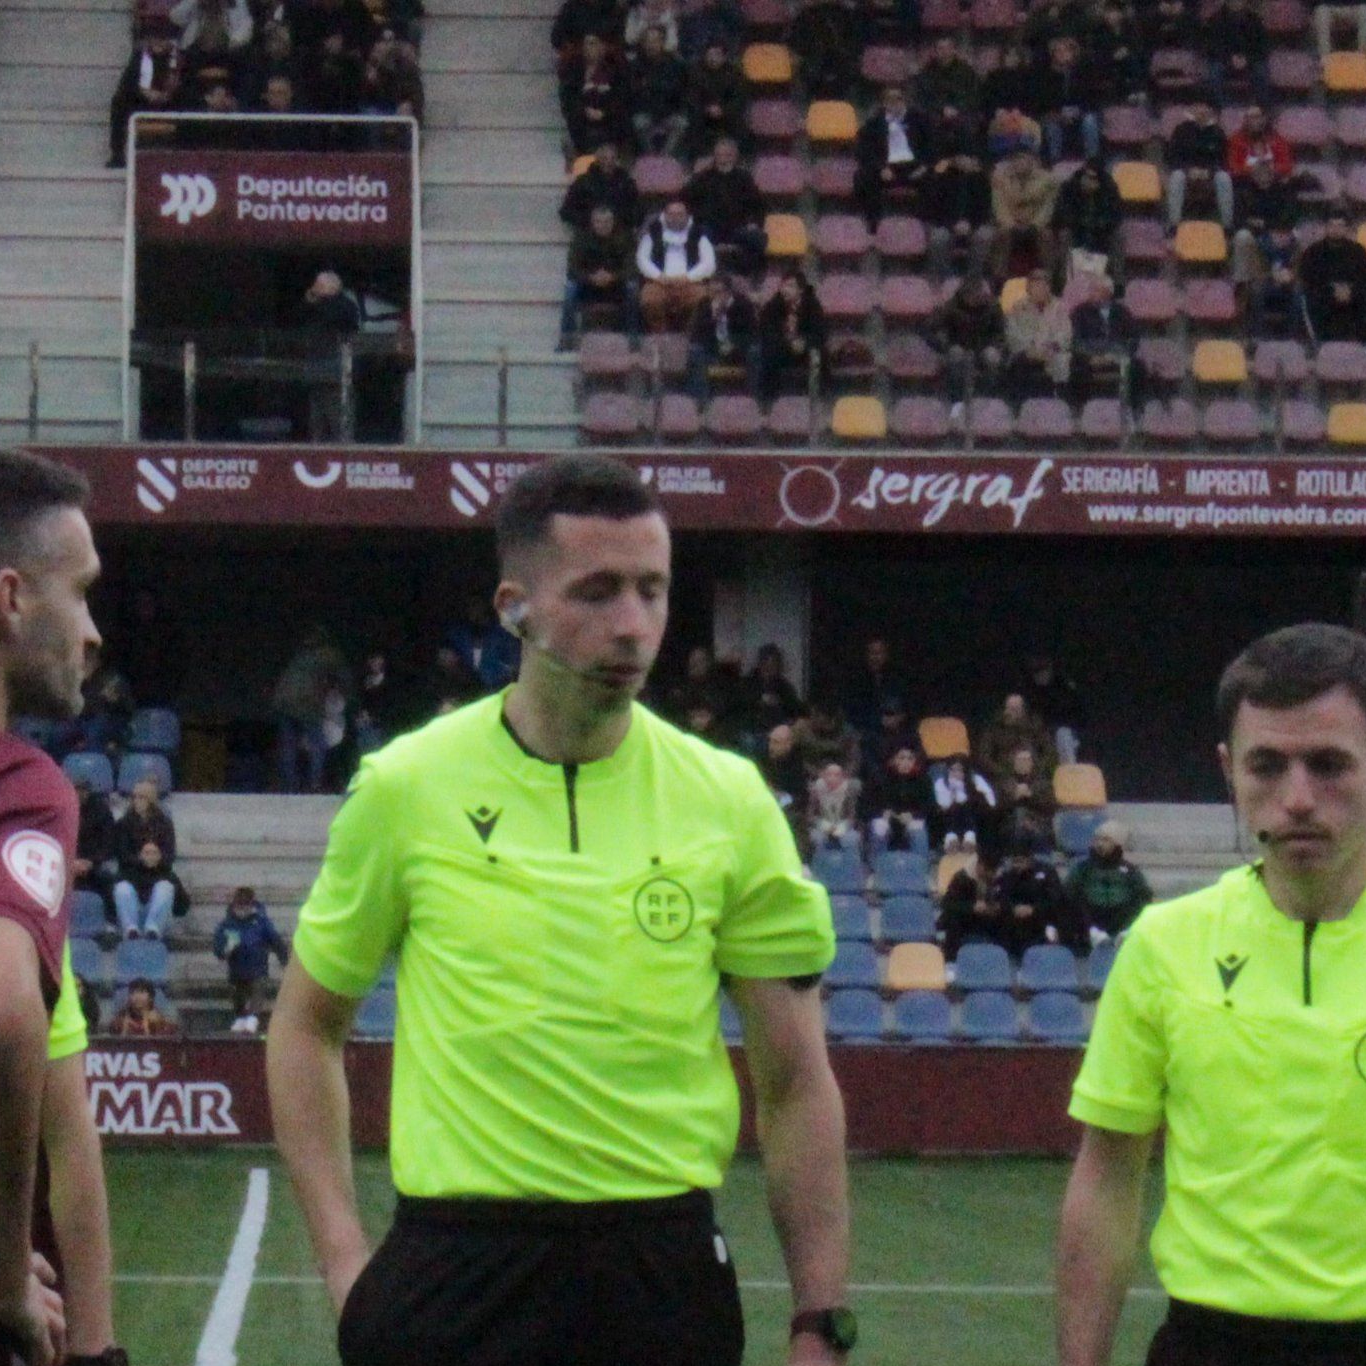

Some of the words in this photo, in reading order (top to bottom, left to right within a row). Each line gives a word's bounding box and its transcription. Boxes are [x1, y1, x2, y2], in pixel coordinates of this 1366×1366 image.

[237, 175, 388, 200] Deputación
[237, 201, 388, 222] Pontevedra
[1186, 468, 1271, 497] IMPRENTA
[85, 1052, 161, 1078] RVAS
[89, 1081, 241, 1135] MAR
